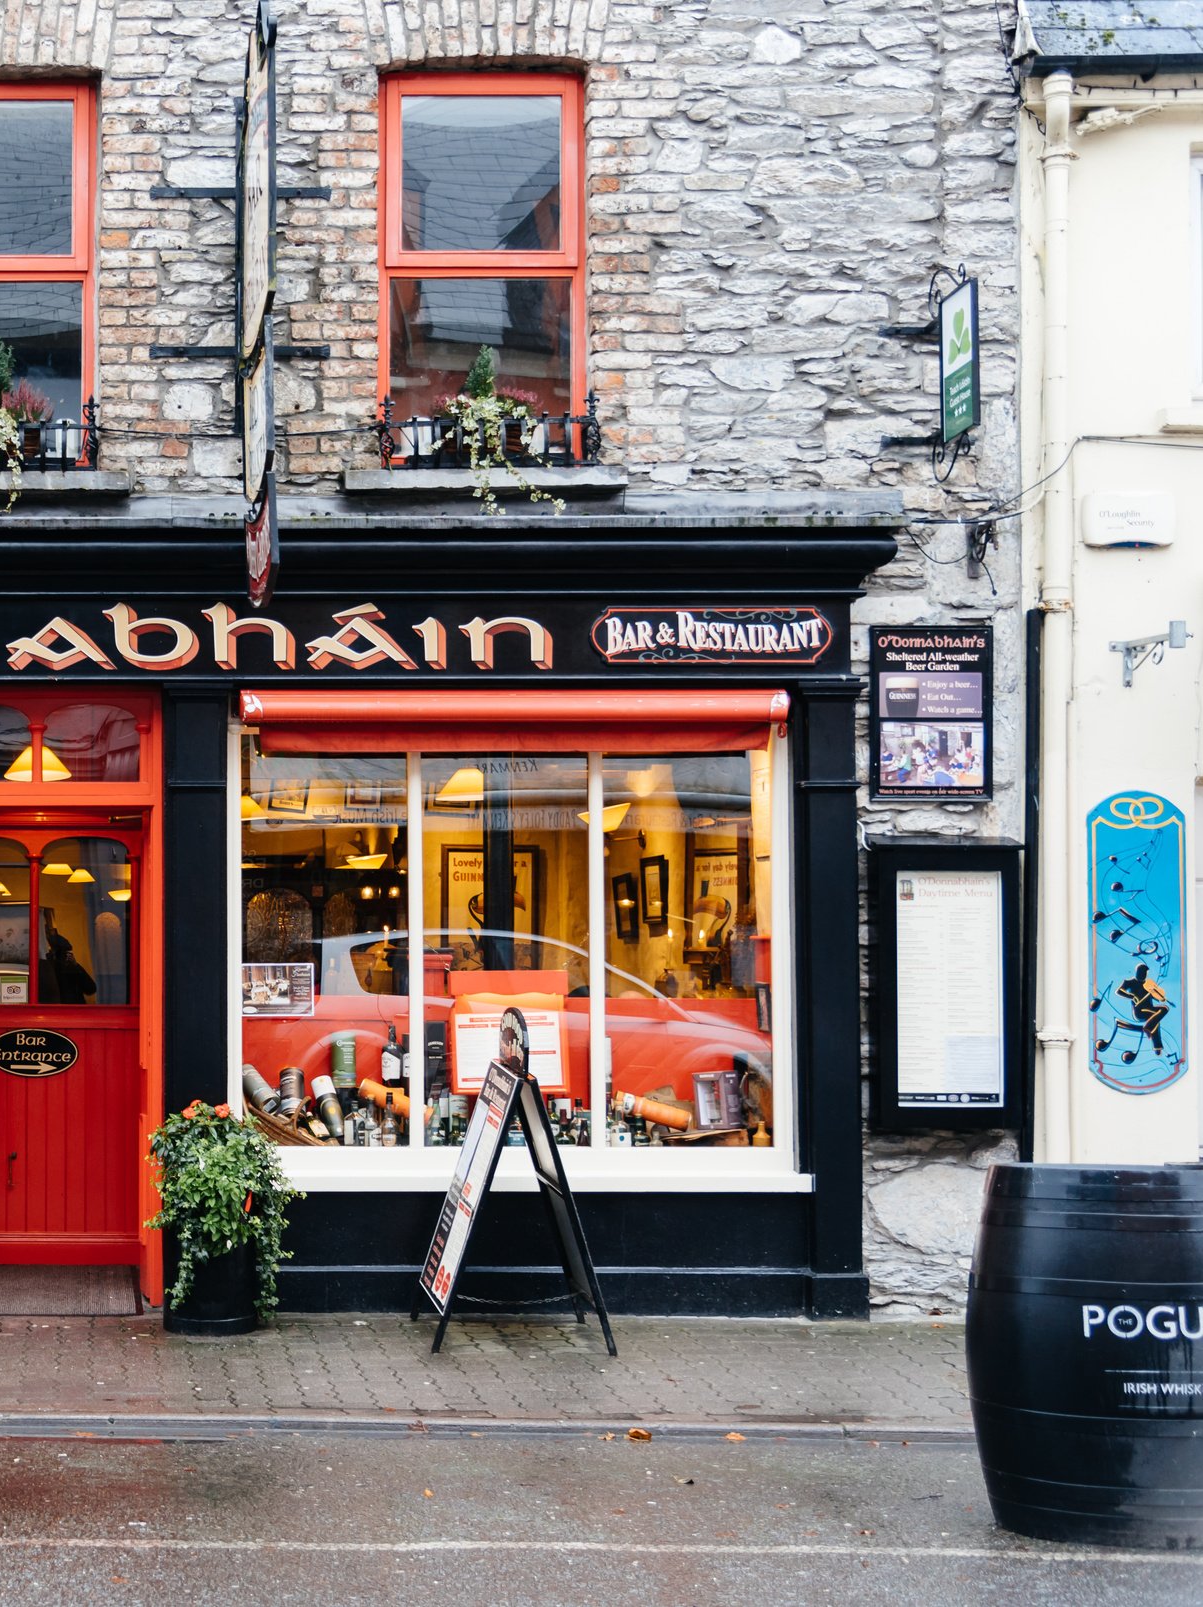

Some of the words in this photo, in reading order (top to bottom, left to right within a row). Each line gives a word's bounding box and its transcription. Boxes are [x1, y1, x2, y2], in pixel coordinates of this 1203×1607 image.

[1126, 520, 1156, 528] Security
[605, 616, 656, 655] BAR
[656, 621, 677, 646] &
[675, 611, 824, 654] RESTAURANT
[886, 652, 927, 661] Sheltered
[928, 652, 980, 661] All-weather
[905, 662, 927, 671] Beer
[927, 662, 960, 671] Garden
[927, 681, 948, 689] Enjoy
[453, 857, 483, 871] Lovely
[453, 871, 484, 882] GUINN
[918, 888, 960, 899] Daytime
[964, 889, 993, 897] Menu
[16, 1033, 47, 1046] Bar
[1082, 1304, 1203, 1340] POGU
[1118, 1318, 1133, 1326] THE
[1123, 1382, 1157, 1395] IRISH
[1160, 1382, 1203, 1396] WHISK
